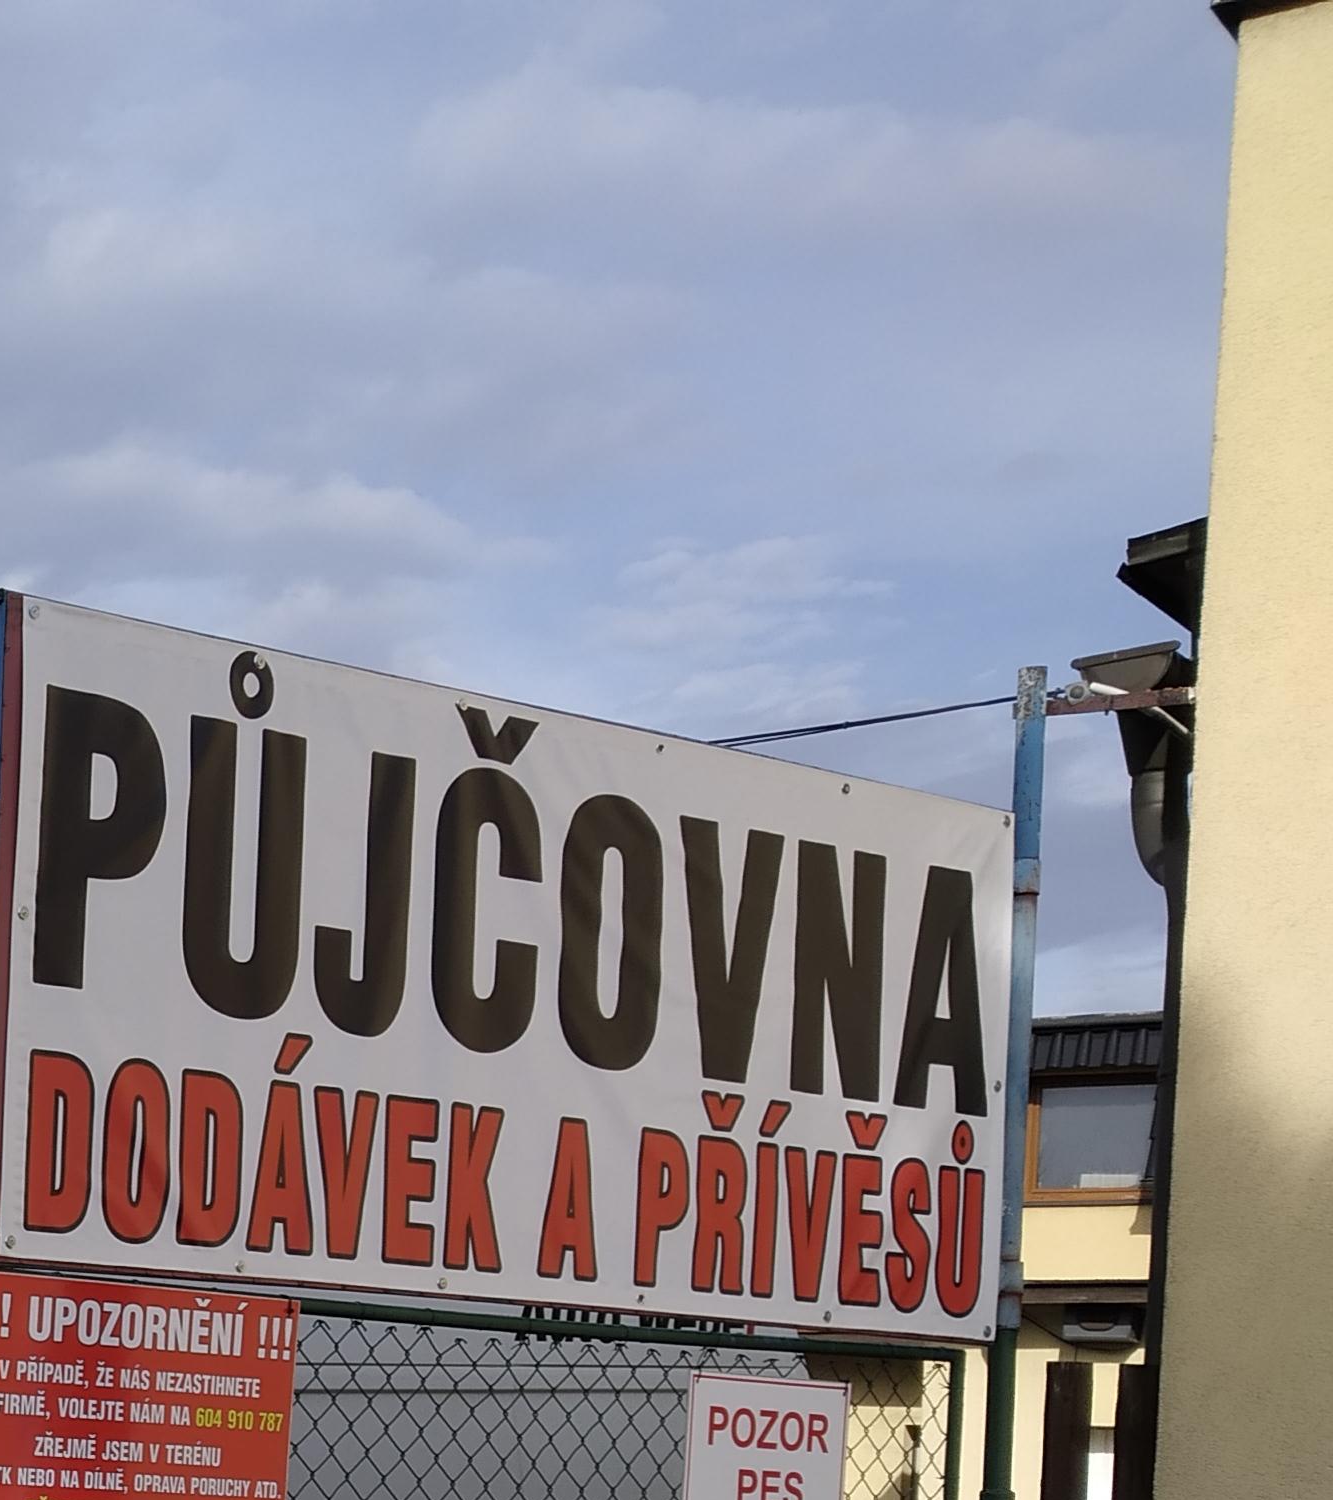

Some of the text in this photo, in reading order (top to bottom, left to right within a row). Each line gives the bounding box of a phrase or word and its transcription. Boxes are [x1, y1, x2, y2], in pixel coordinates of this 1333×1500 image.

[32, 650, 988, 1117] PŮJČOVNA
[23, 1033, 986, 1318] DODÁVEK A PŘÍVĚSŮ
[28, 1297, 248, 1357] UPOZORNĚNÍ
[0, 1356, 261, 1398] V PŘÍPADĚ, ŽE NÁS NEZASTIHNETE
[58, 1397, 124, 1422] VOLEJTE
[130, 1398, 165, 1424] NÁM
[170, 1407, 191, 1427] NA
[196, 1408, 222, 1428] 604
[228, 1410, 254, 1431] 910
[259, 1412, 284, 1432] 787
[707, 1405, 829, 1453] POZOR
[34, 1433, 221, 1467] ZŘEJMĚ JSEM V TERÉNU
[17, 1467, 55, 1488] NEBO
[60, 1469, 80, 1489] NA
[84, 1464, 129, 1494] DÍLNĚ,
[133, 1473, 186, 1495] OPRAVA
[190, 1477, 250, 1498] PORUCHY
[254, 1480, 282, 1500] ATD.
